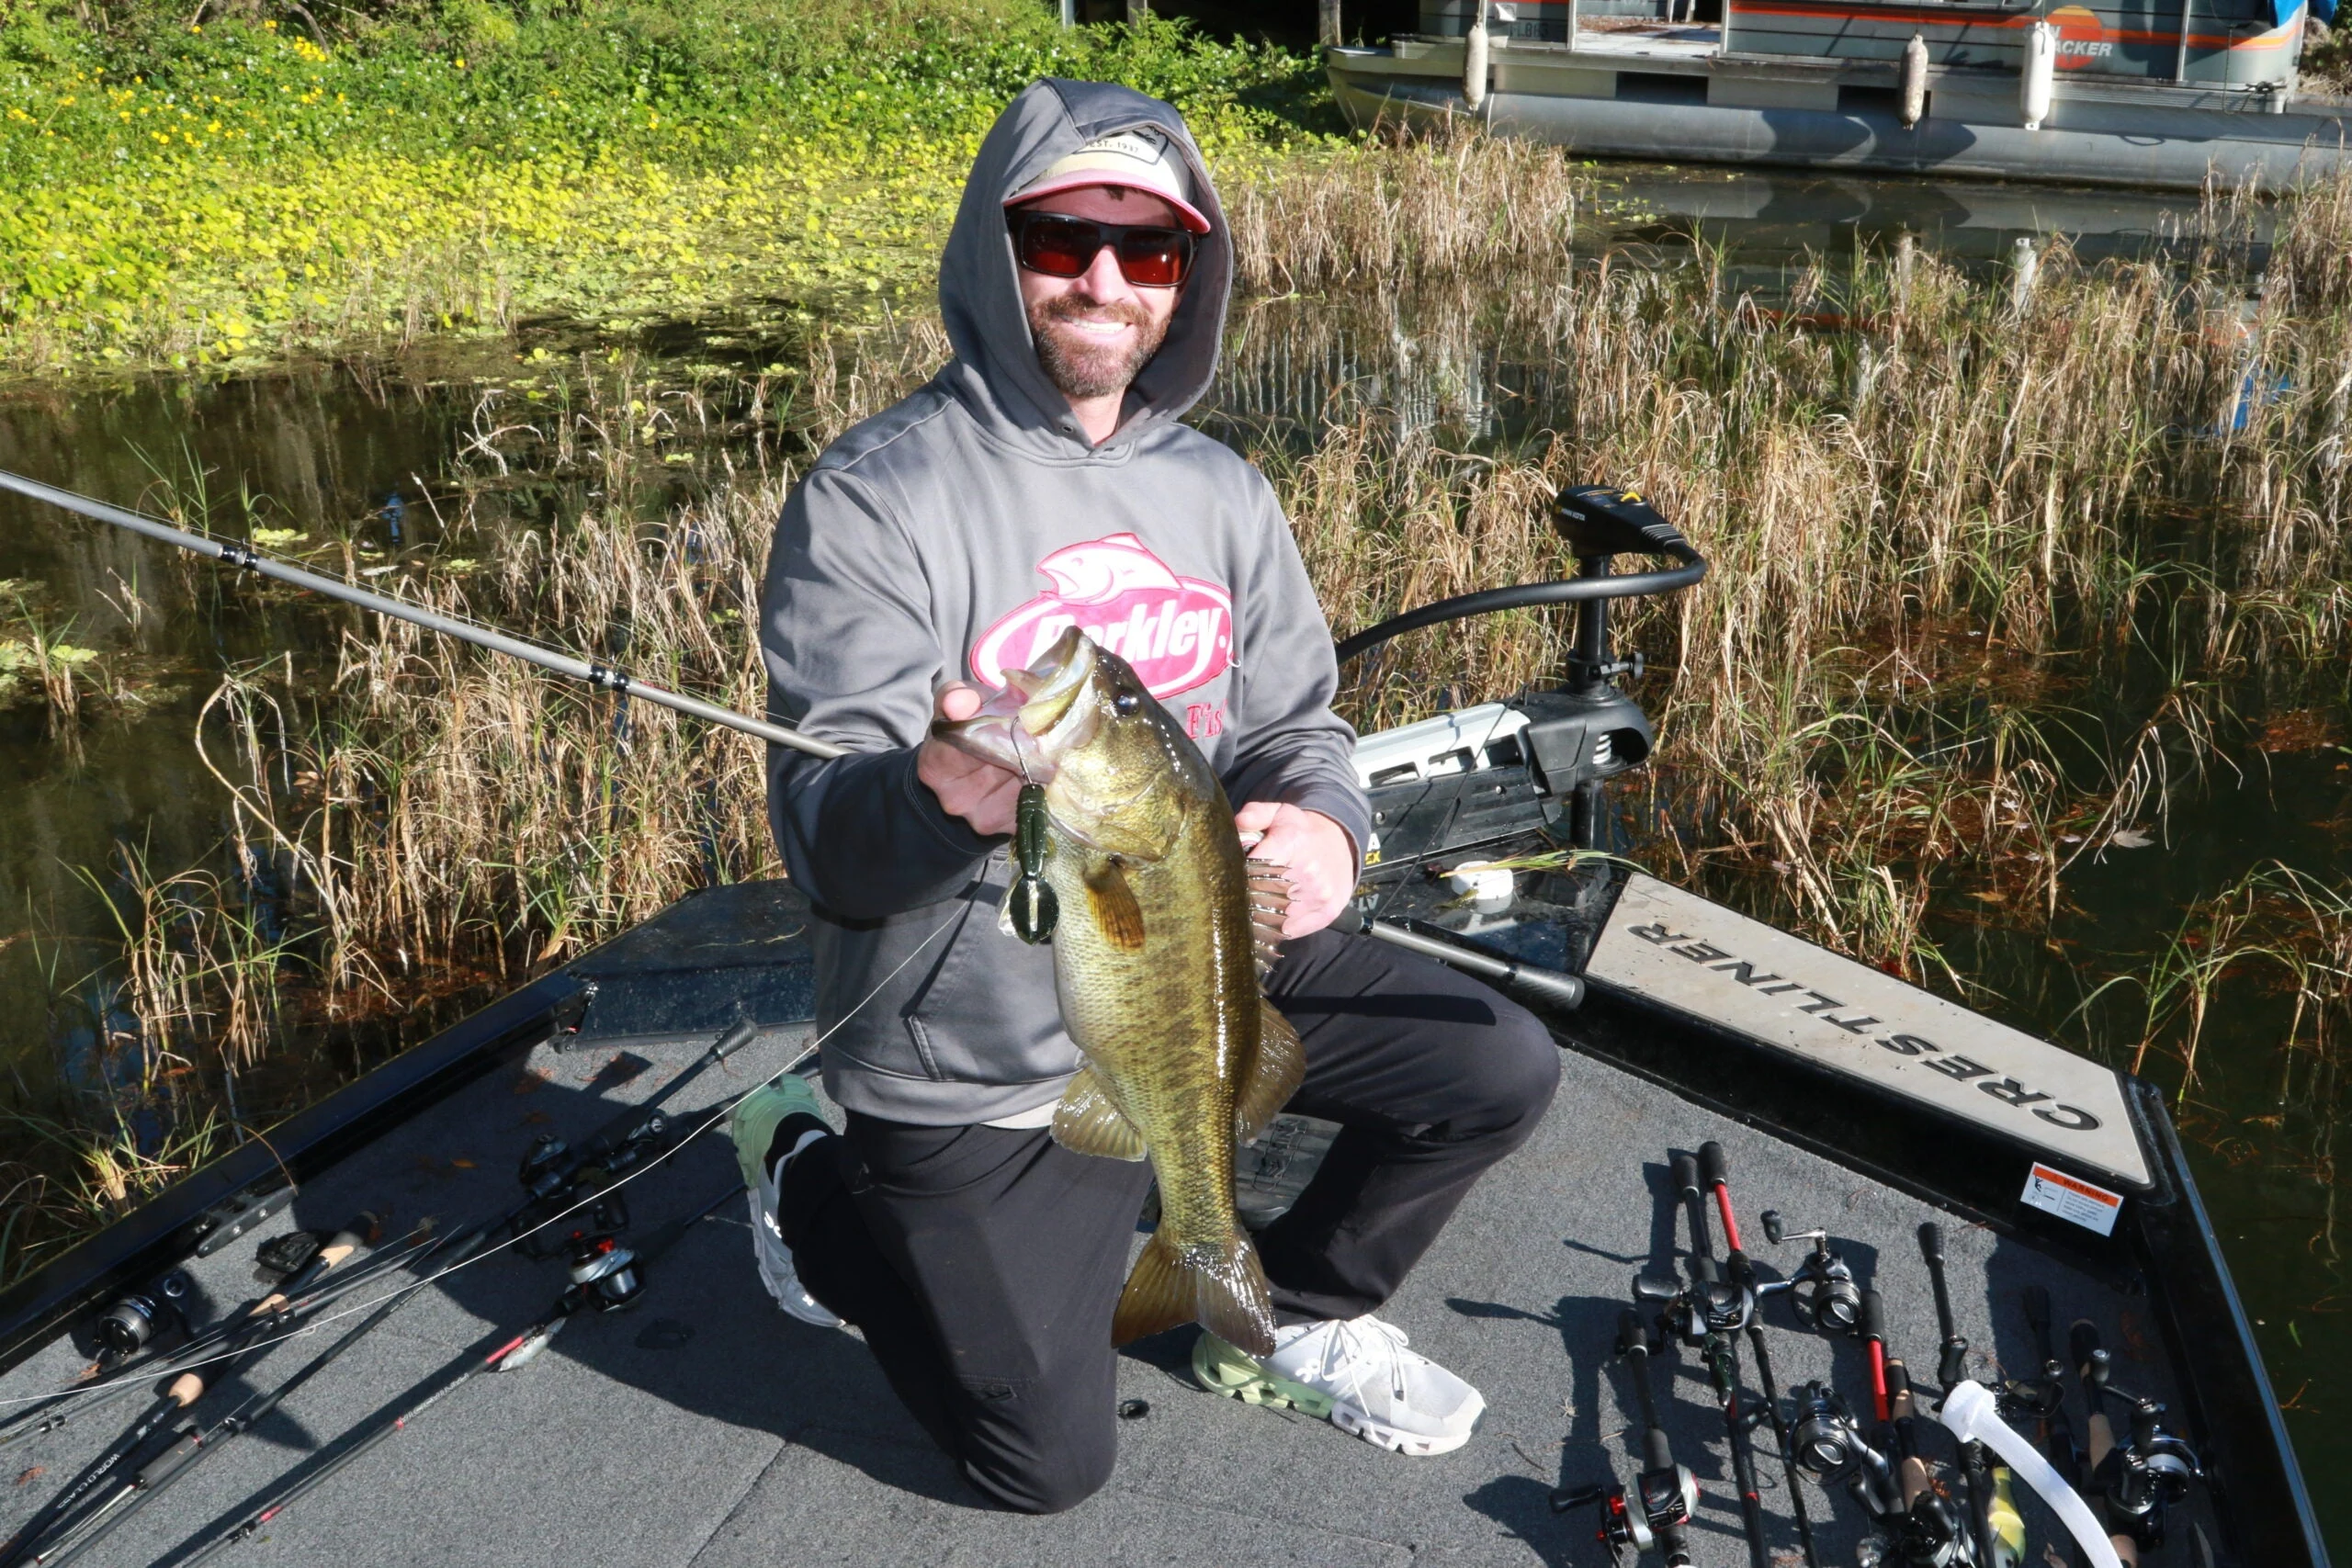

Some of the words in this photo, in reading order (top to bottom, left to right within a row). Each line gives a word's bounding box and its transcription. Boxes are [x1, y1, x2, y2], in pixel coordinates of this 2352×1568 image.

[2055, 40, 2112, 56] ACKER
[1186, 699, 1228, 740] Fis
[1628, 921, 2102, 1132] CRESTLINER
[2064, 1179, 2109, 1201] WARNING
